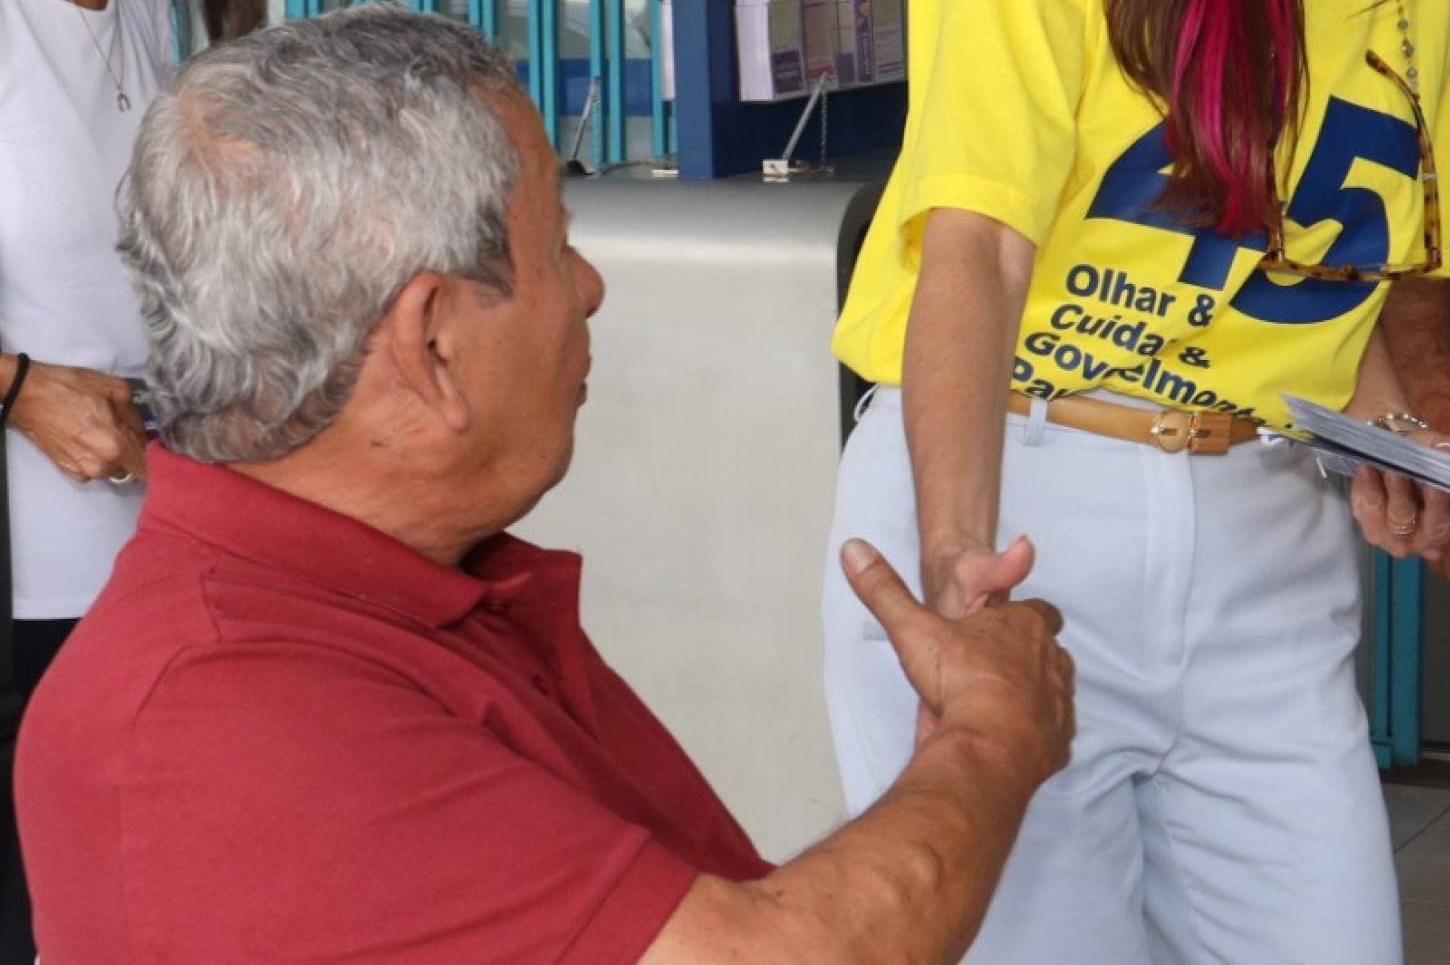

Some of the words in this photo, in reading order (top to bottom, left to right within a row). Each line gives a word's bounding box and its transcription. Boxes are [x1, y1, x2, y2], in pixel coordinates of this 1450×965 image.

[1066, 264, 1176, 317] Olhar
[1188, 294, 1215, 326] &
[1051, 304, 1180, 357] Cuida
[1178, 346, 1211, 369] &
